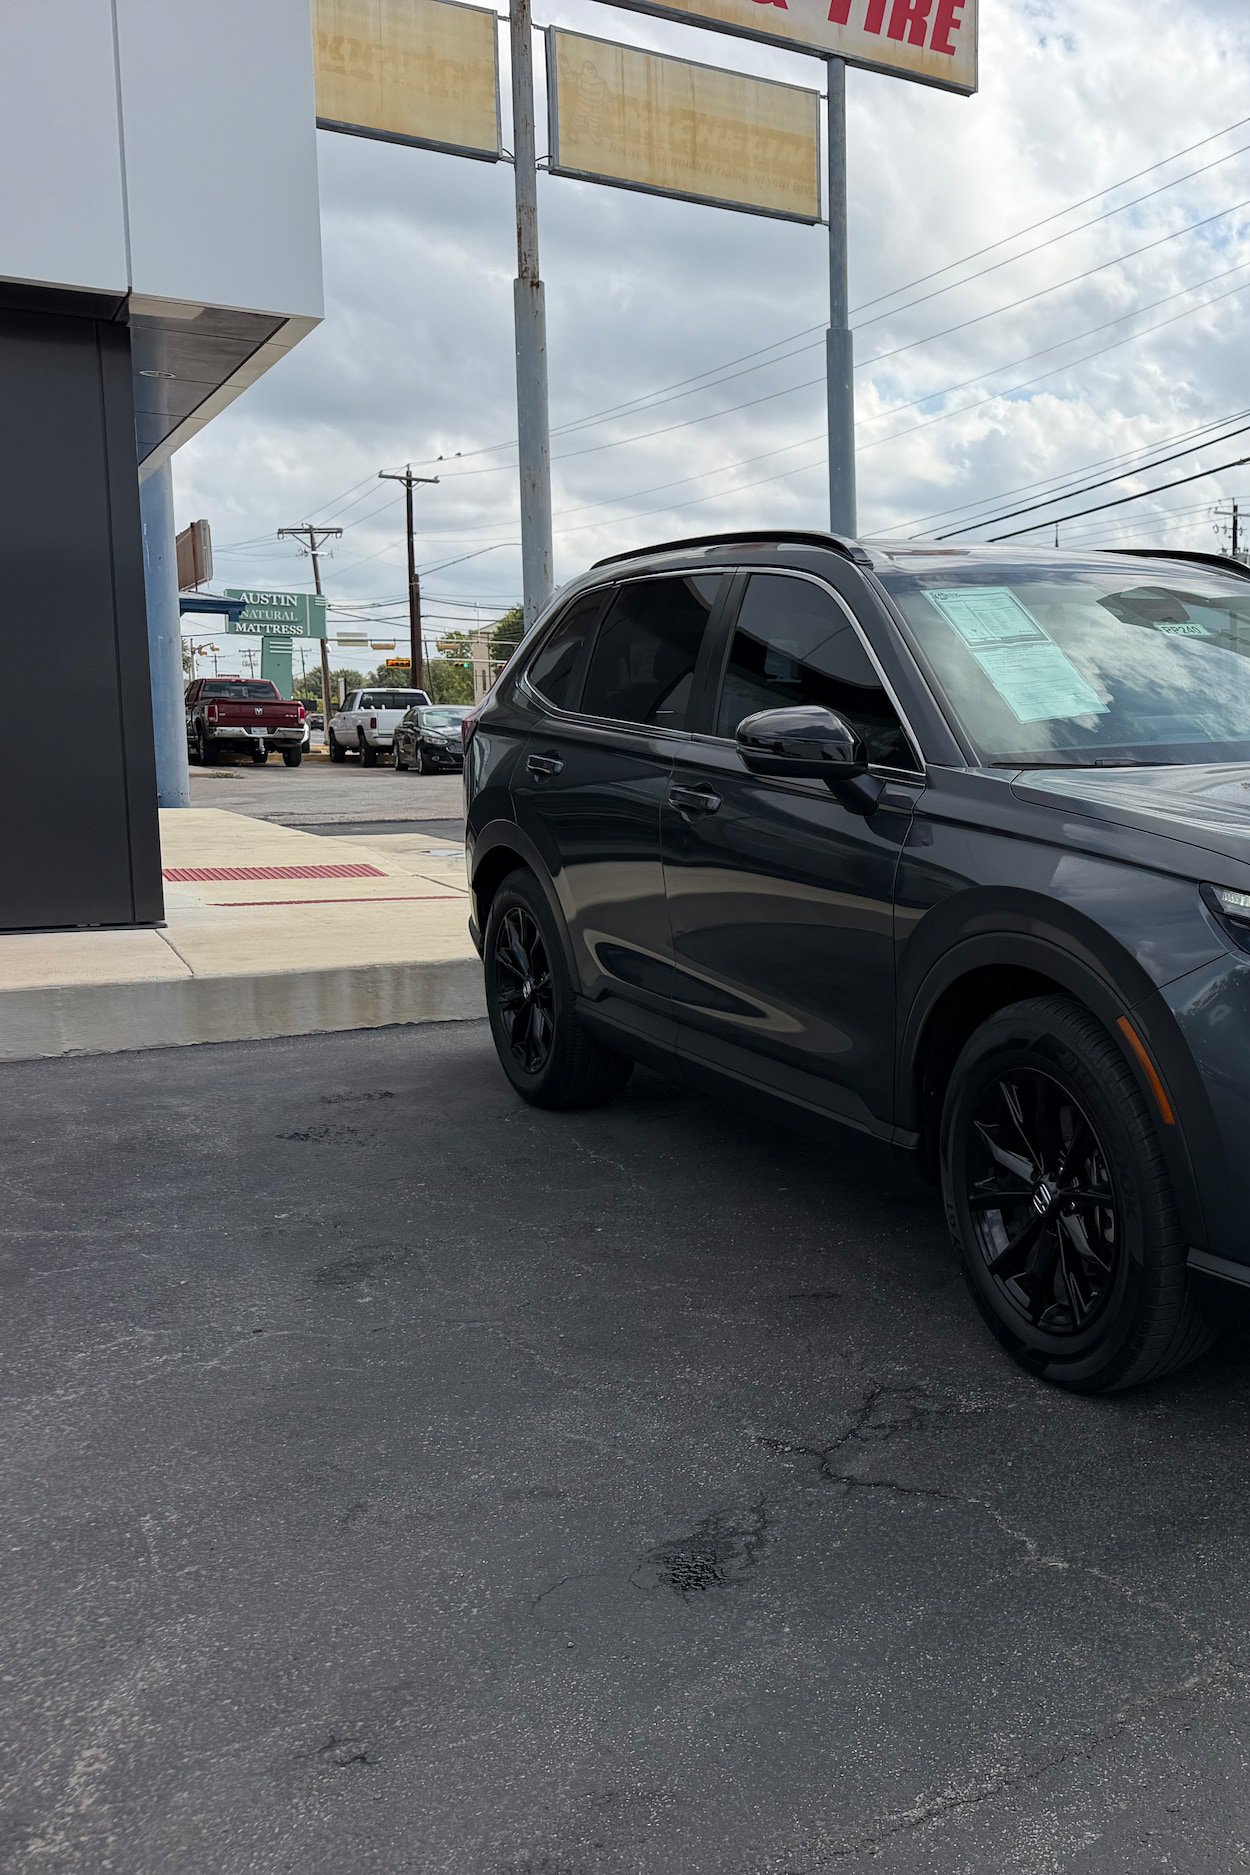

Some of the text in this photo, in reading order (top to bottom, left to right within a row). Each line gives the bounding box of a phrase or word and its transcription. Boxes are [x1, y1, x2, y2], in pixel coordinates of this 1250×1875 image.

[240, 592, 298, 606] AUSTIN
[240, 609, 298, 621] NATURAL
[235, 622, 304, 635] MATTRESS
